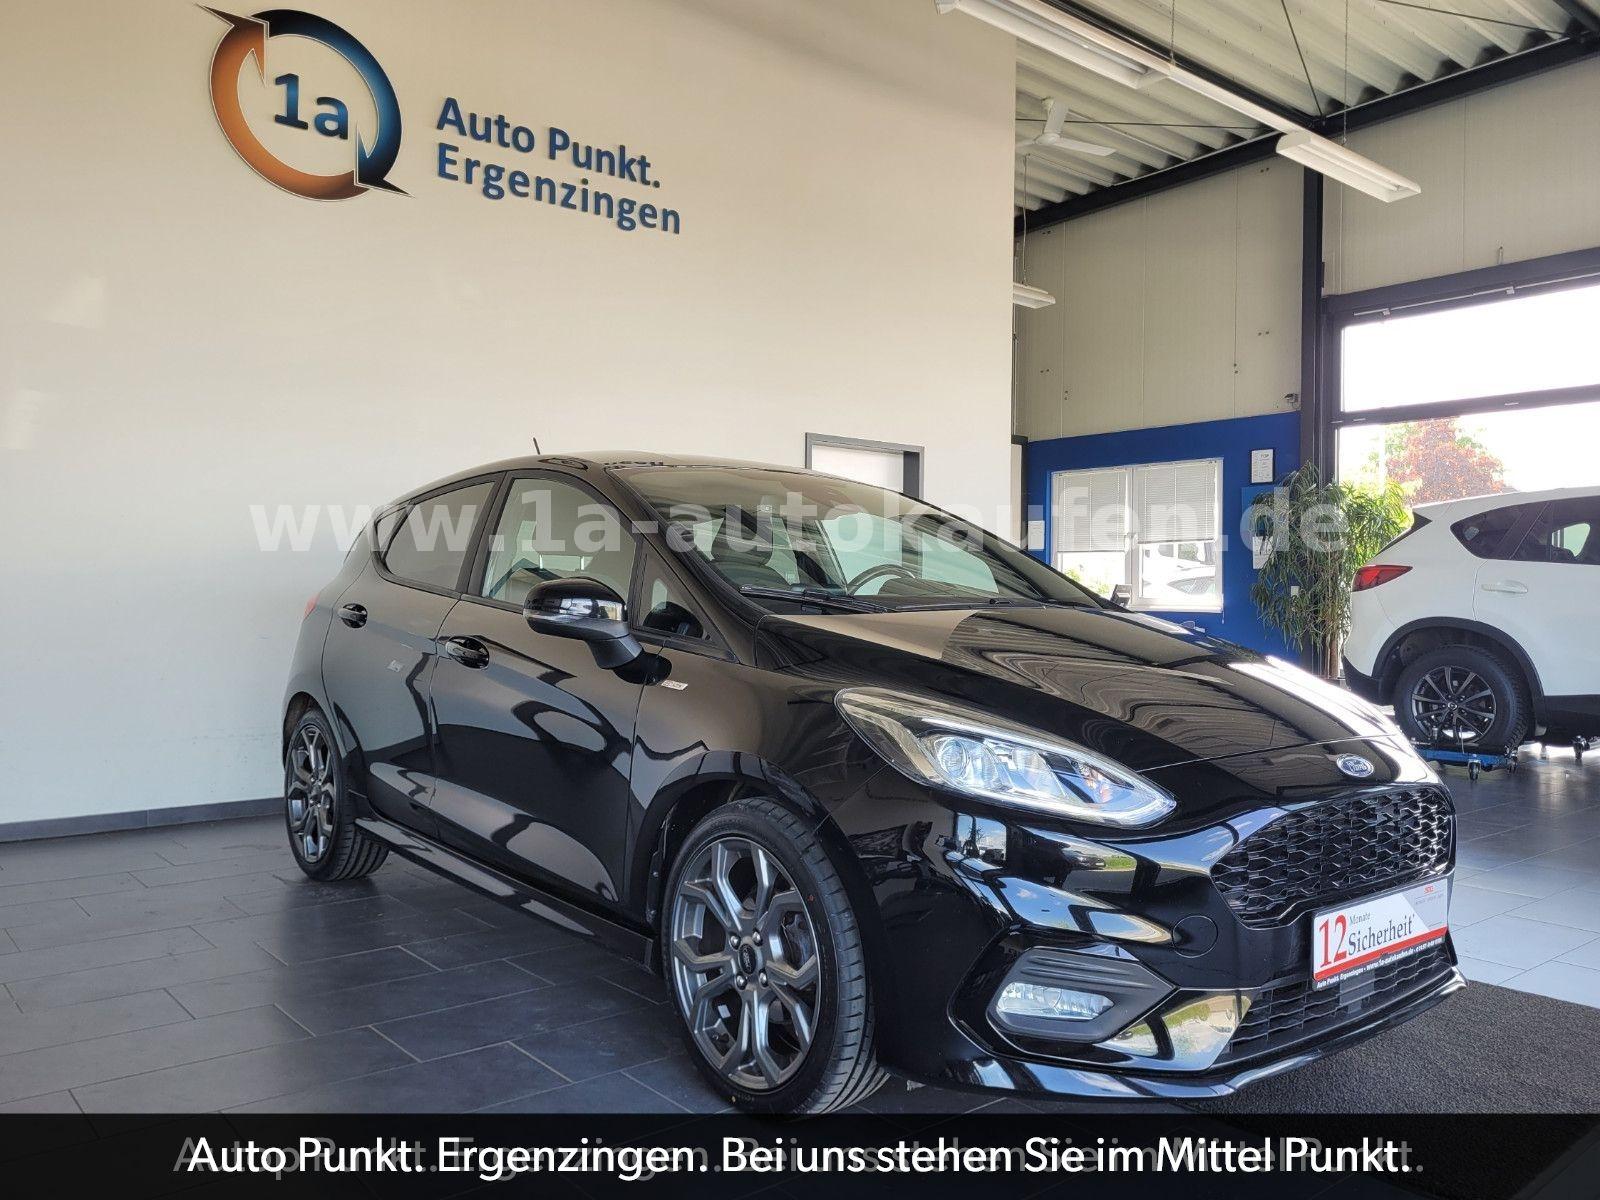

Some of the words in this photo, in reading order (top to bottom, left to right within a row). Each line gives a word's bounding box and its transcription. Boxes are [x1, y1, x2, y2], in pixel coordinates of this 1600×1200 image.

[273, 72, 349, 139] 1a
[437, 96, 535, 154] Auto
[548, 126, 662, 190] Punkt.
[437, 142, 681, 236] Ergenzingen
[1319, 914, 1347, 968] 12
